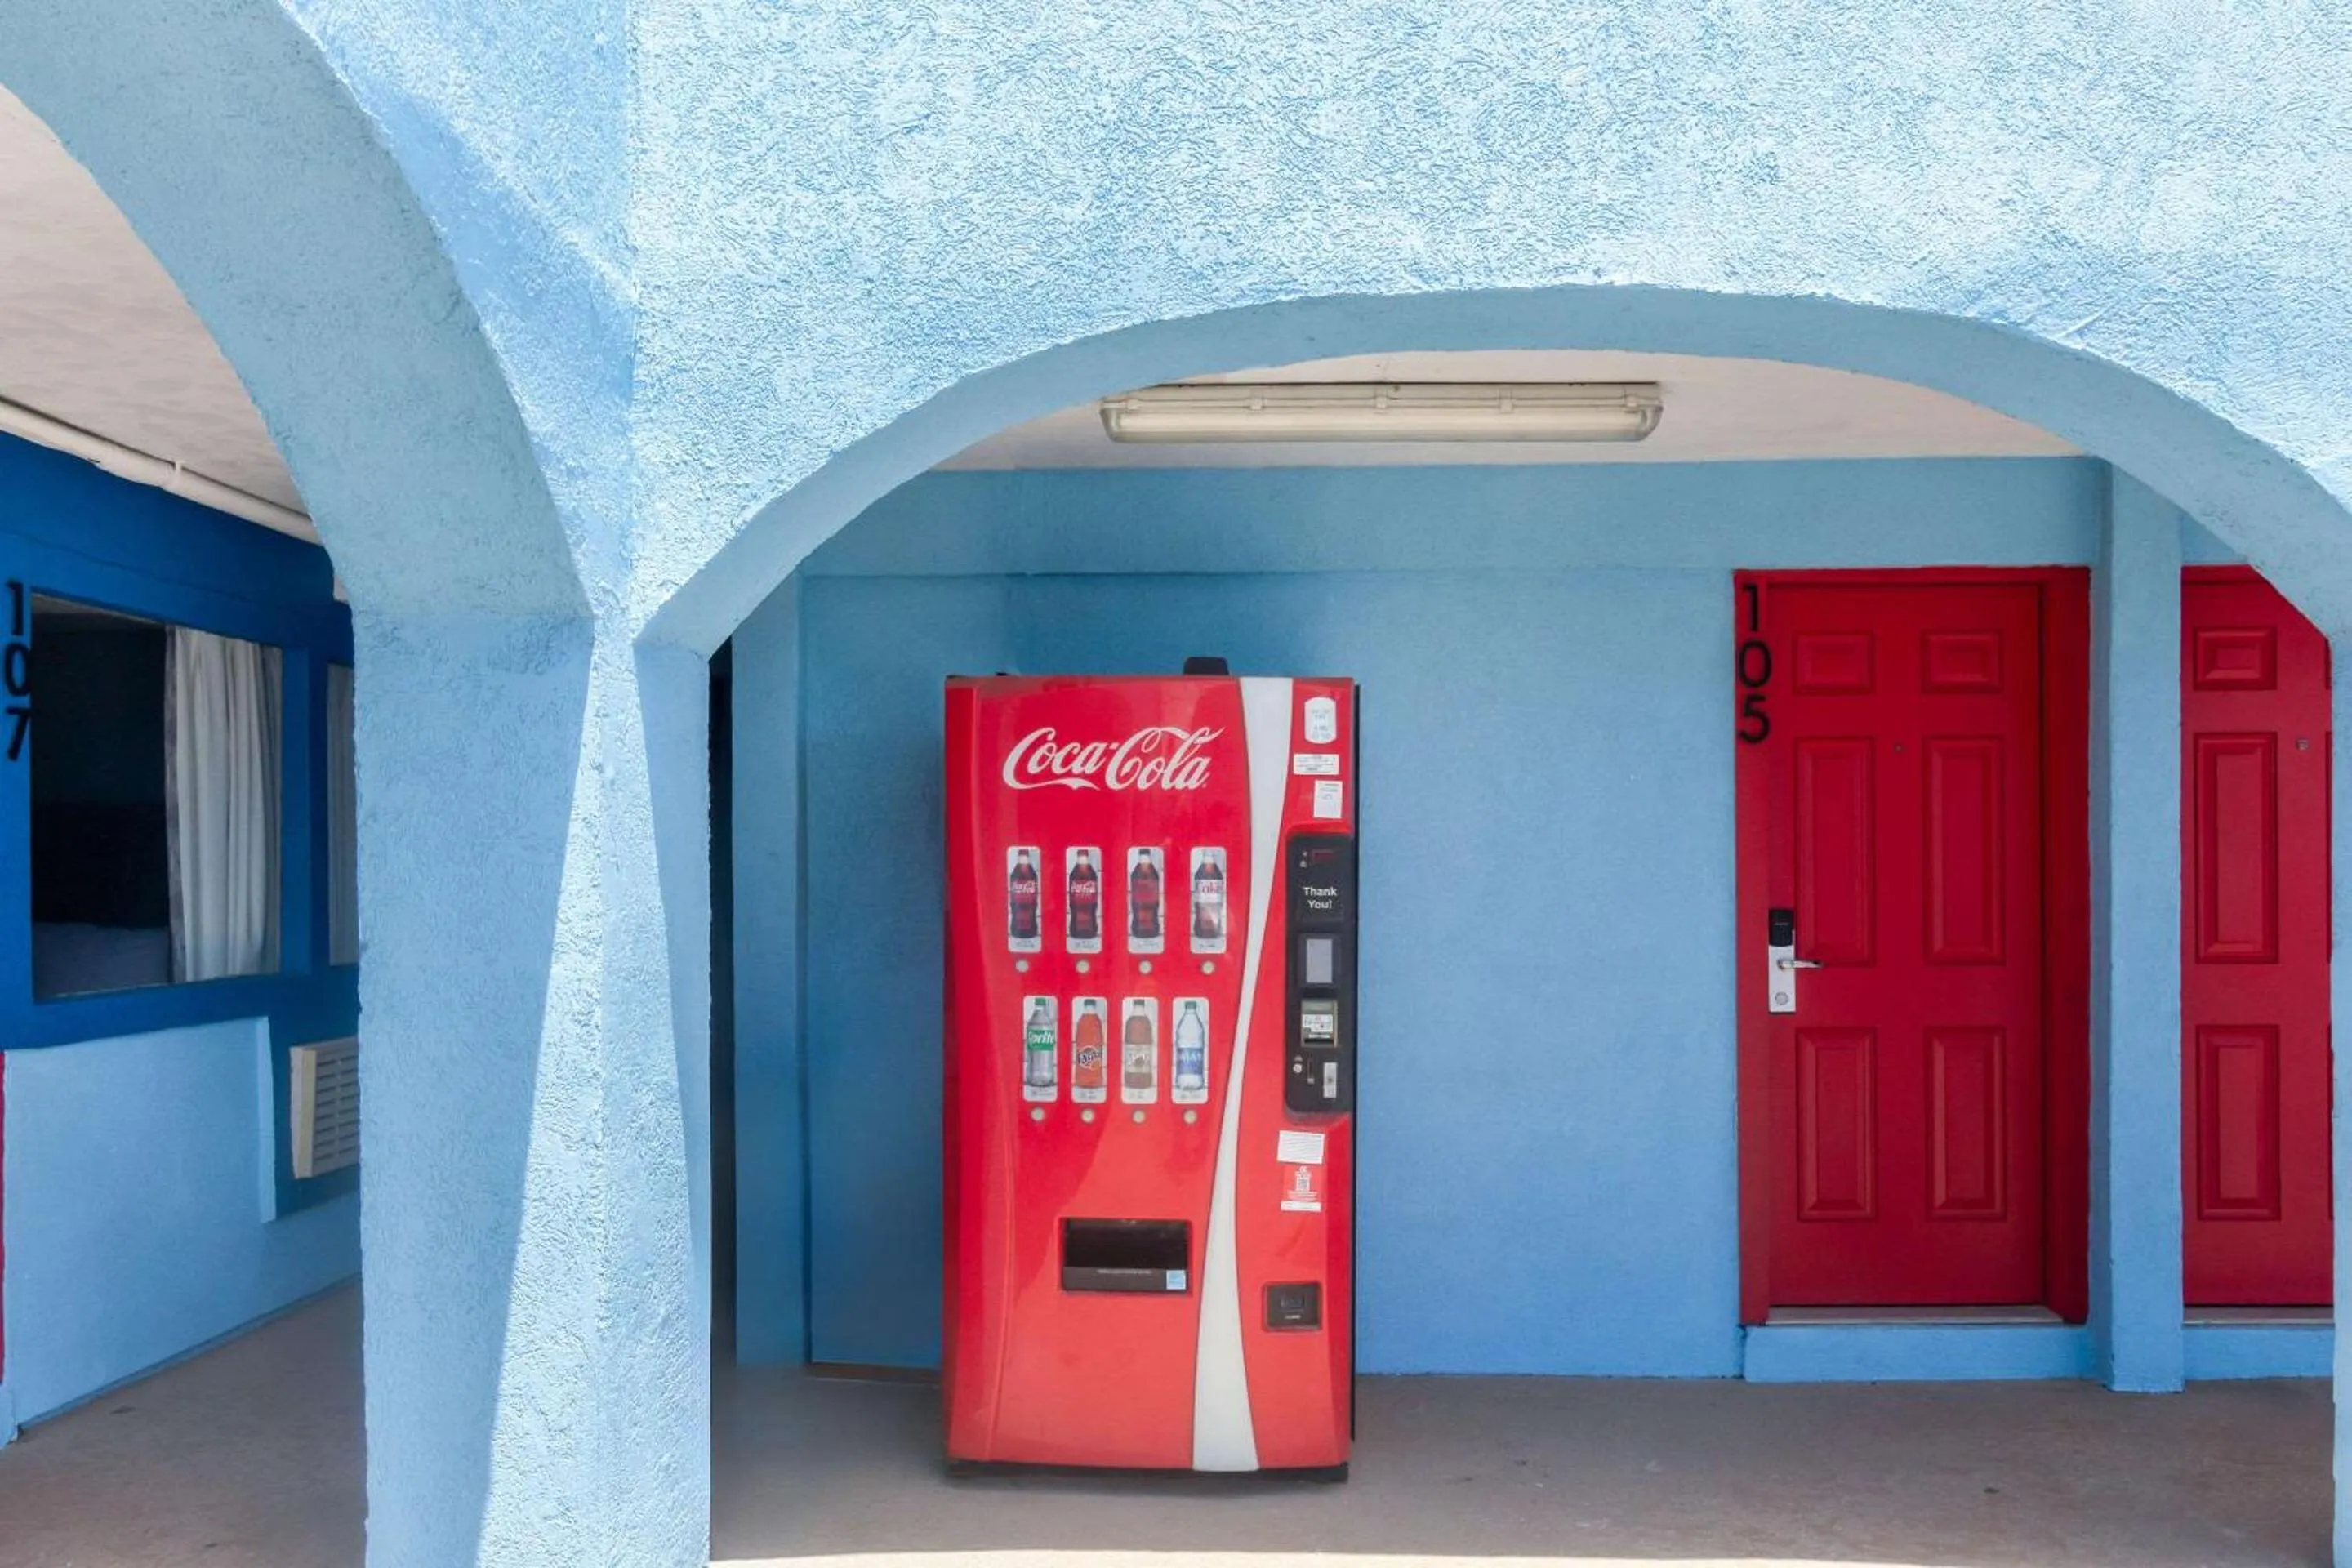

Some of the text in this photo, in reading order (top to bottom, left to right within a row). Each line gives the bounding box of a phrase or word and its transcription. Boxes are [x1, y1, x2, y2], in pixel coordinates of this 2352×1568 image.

[5, 580, 31, 762] 107
[1739, 583, 1772, 744] 105
[1002, 726, 1225, 791] Coca-Cola
[1303, 886, 1338, 896] Thank
[1308, 900, 1332, 909] You!
